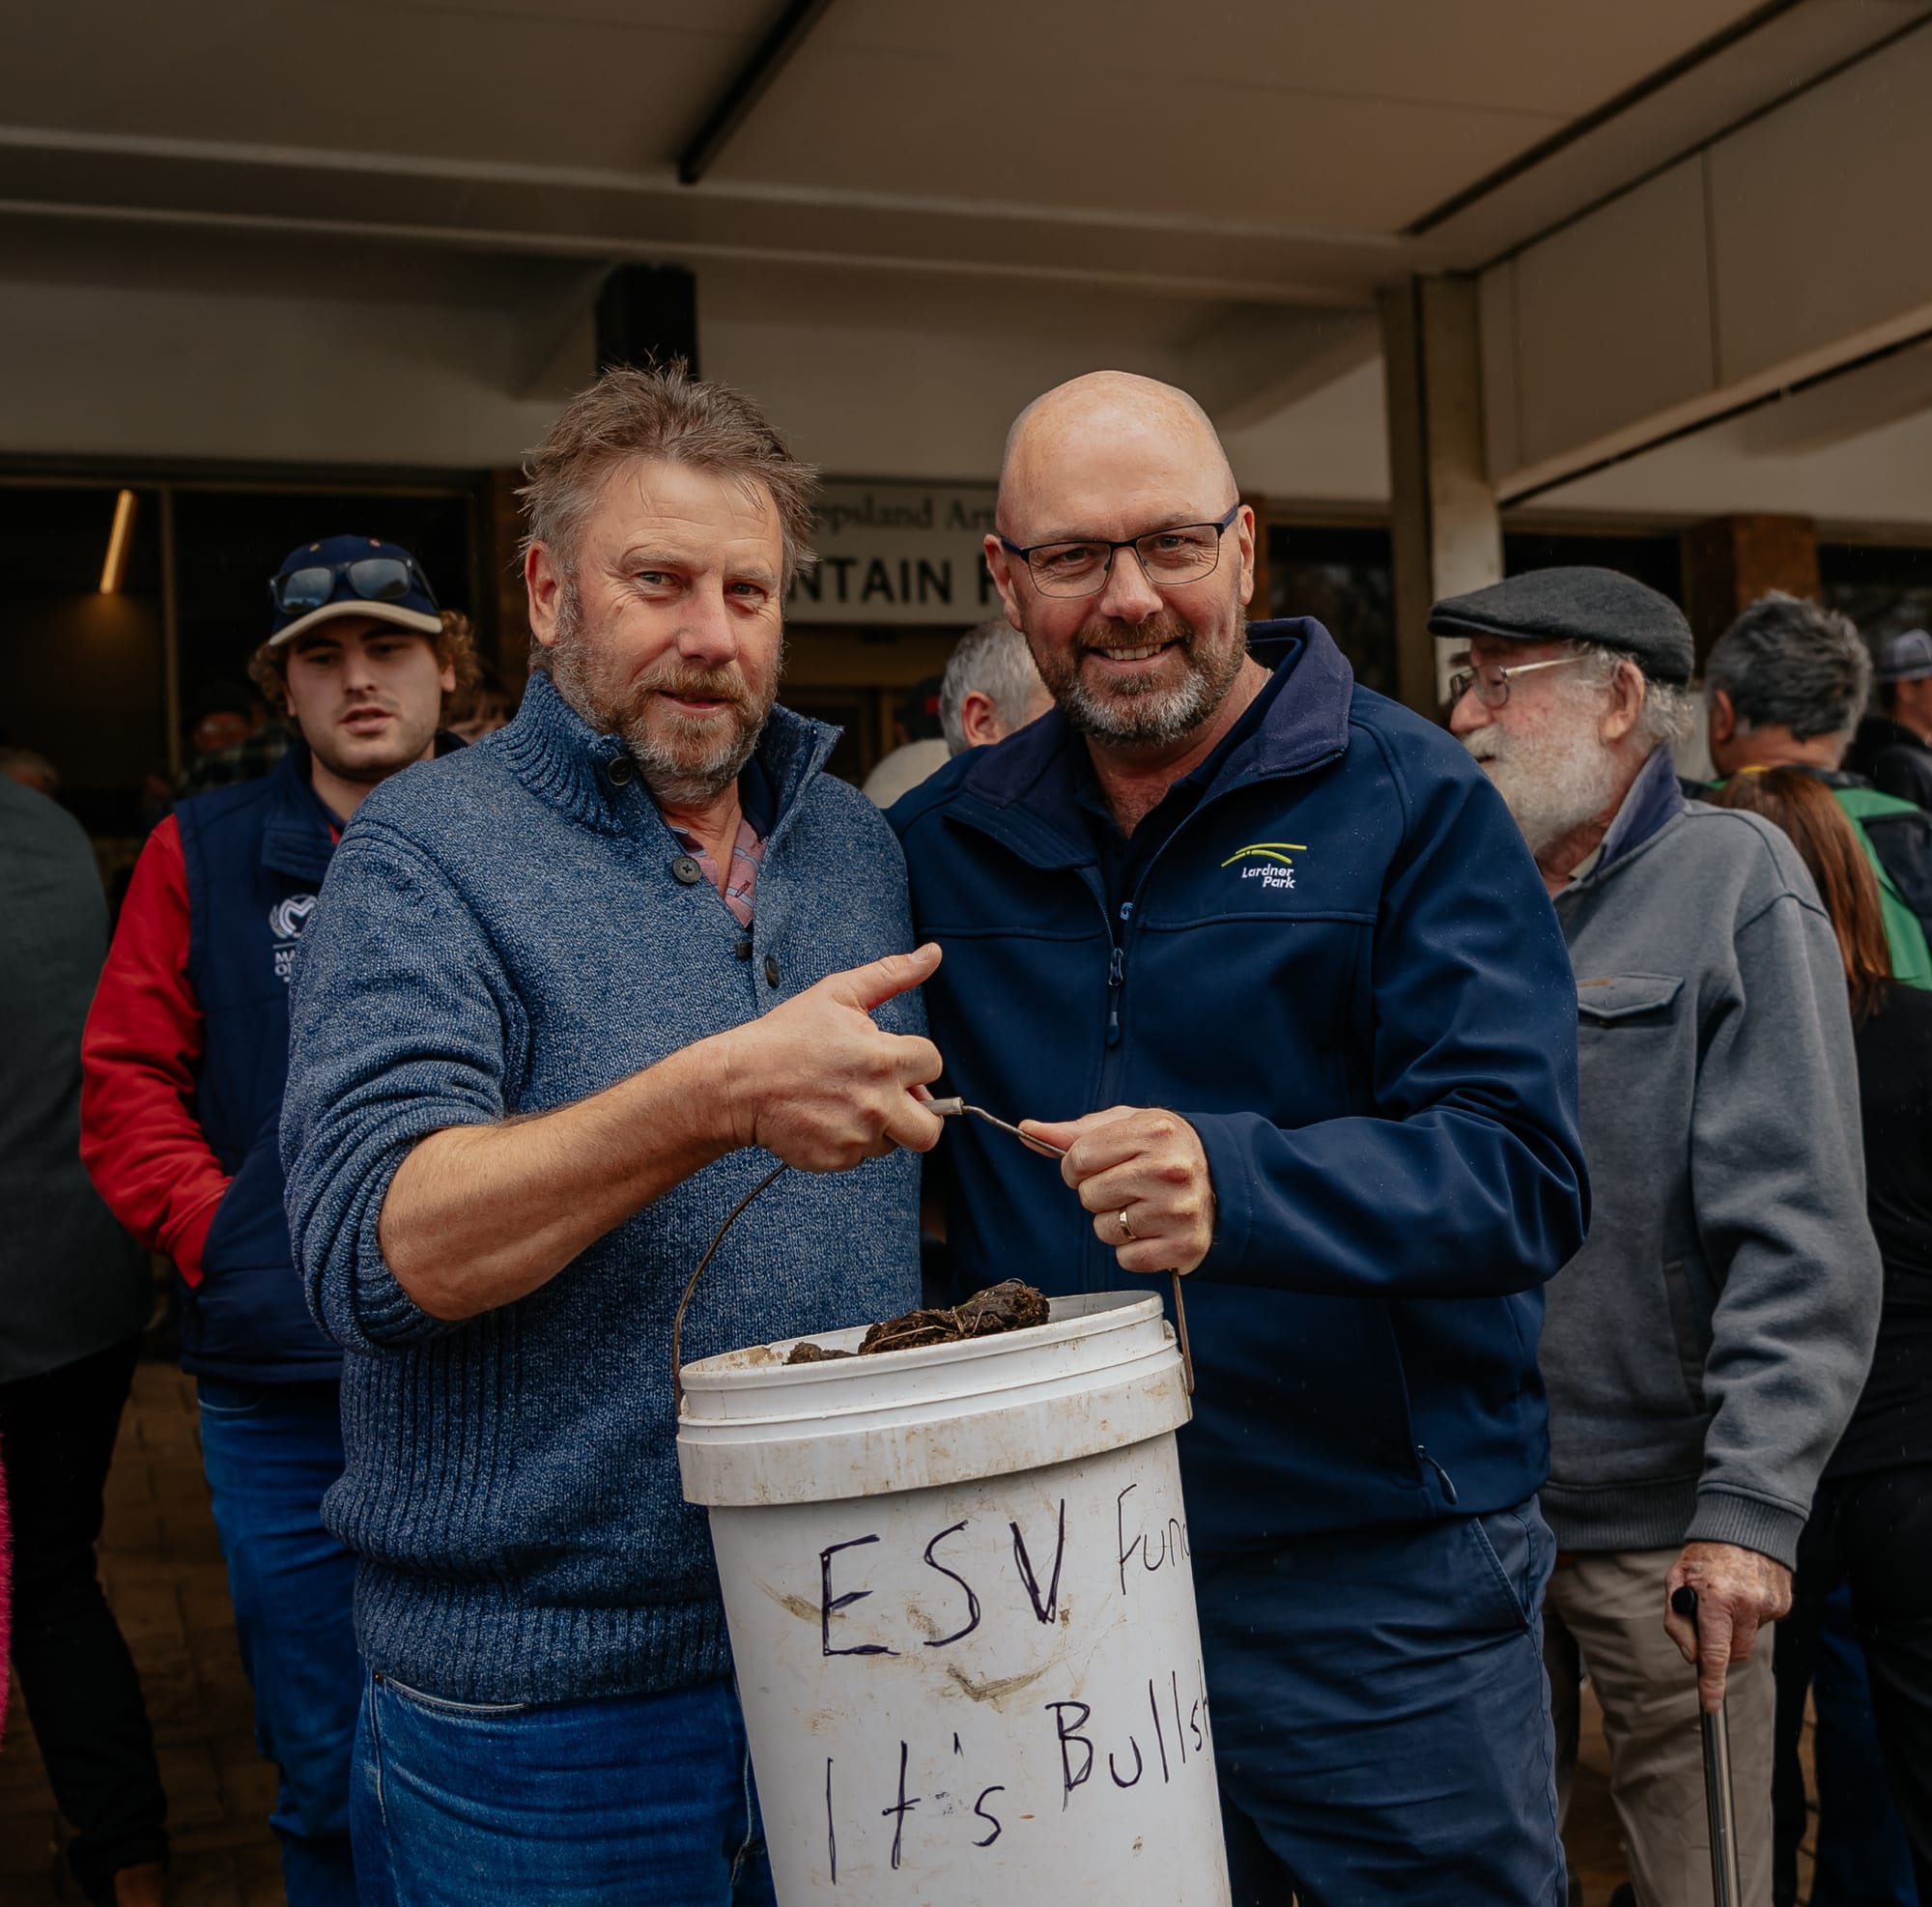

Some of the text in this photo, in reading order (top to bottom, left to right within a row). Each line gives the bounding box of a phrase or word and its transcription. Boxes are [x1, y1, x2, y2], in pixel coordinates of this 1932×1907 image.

[1241, 864, 1294, 878] Lardner
[1263, 876, 1295, 889] Park
[819, 1498, 1065, 1656] ESV
[828, 1732, 1006, 1885] It's
